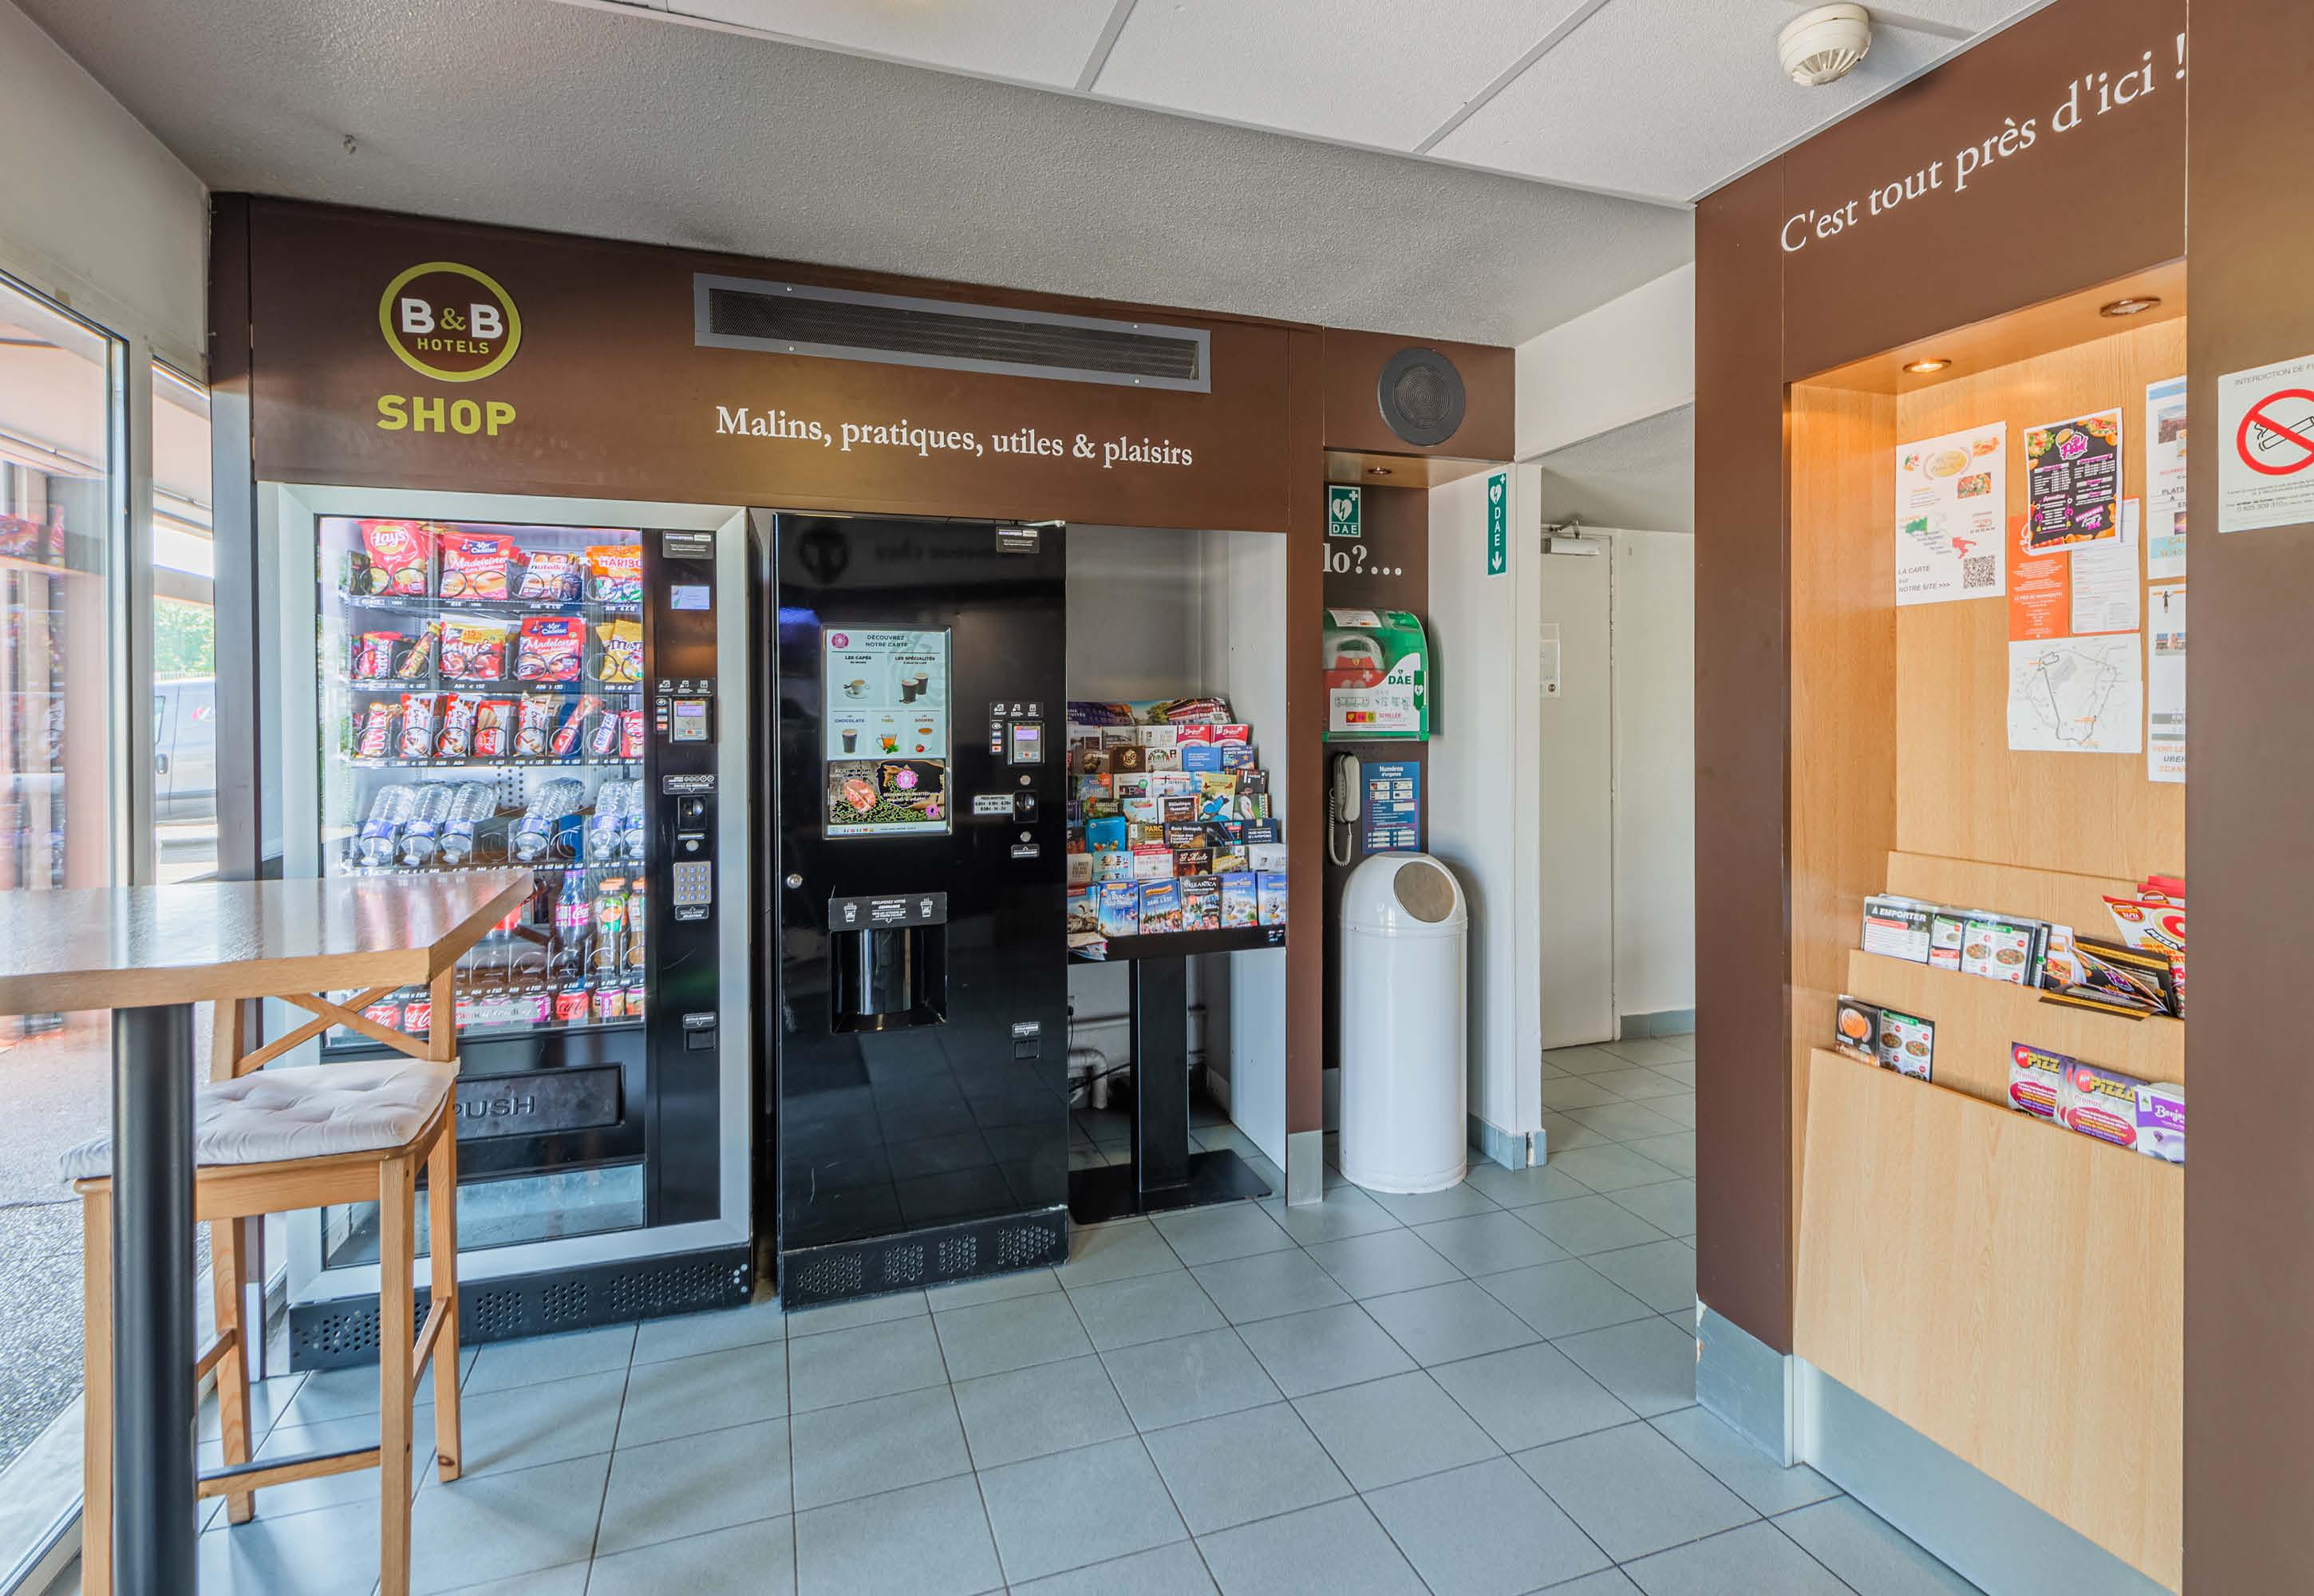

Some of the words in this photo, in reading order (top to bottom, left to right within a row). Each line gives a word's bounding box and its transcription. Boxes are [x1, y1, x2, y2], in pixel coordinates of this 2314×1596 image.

[1780, 199, 1858, 253] C'est
[1869, 160, 1944, 215] tout
[1954, 117, 2036, 192] près
[2051, 49, 2155, 134] d'ici
[2175, 32, 2186, 81] !
[417, 338, 490, 354] HOTELS
[377, 394, 516, 436] SHOP
[715, 405, 833, 448] Malins,
[840, 420, 985, 457] pratiques,
[992, 428, 1064, 456] utiles
[1072, 433, 1096, 459] &
[1103, 436, 1193, 468] plaisirs
[1333, 523, 1358, 535] DAE
[1909, 565, 1931, 574] CARTE
[1388, 675, 1412, 685] DAE
[1879, 907, 1927, 922] EMPORTER
